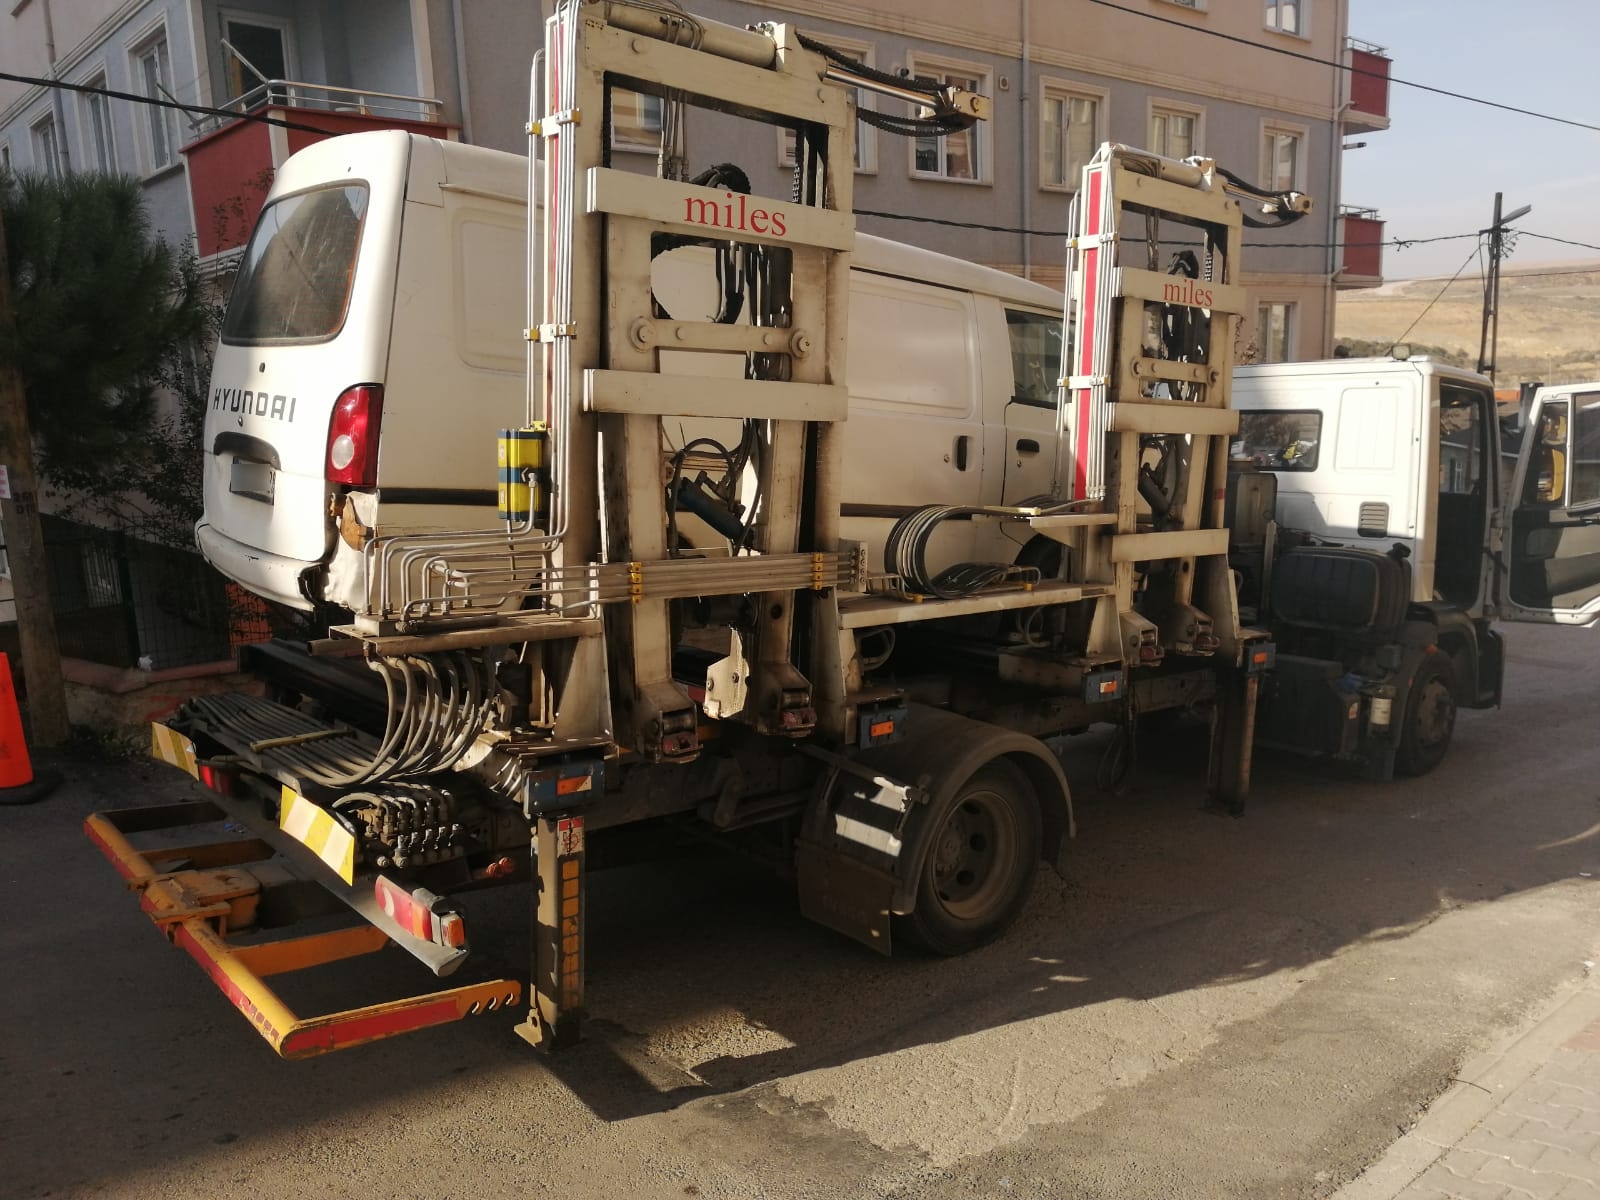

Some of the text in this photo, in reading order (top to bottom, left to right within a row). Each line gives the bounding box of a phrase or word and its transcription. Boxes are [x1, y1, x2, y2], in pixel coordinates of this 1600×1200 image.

[684, 192, 787, 237] miles
[1163, 278, 1213, 307] miles
[212, 388, 297, 423] HYUNDAI
